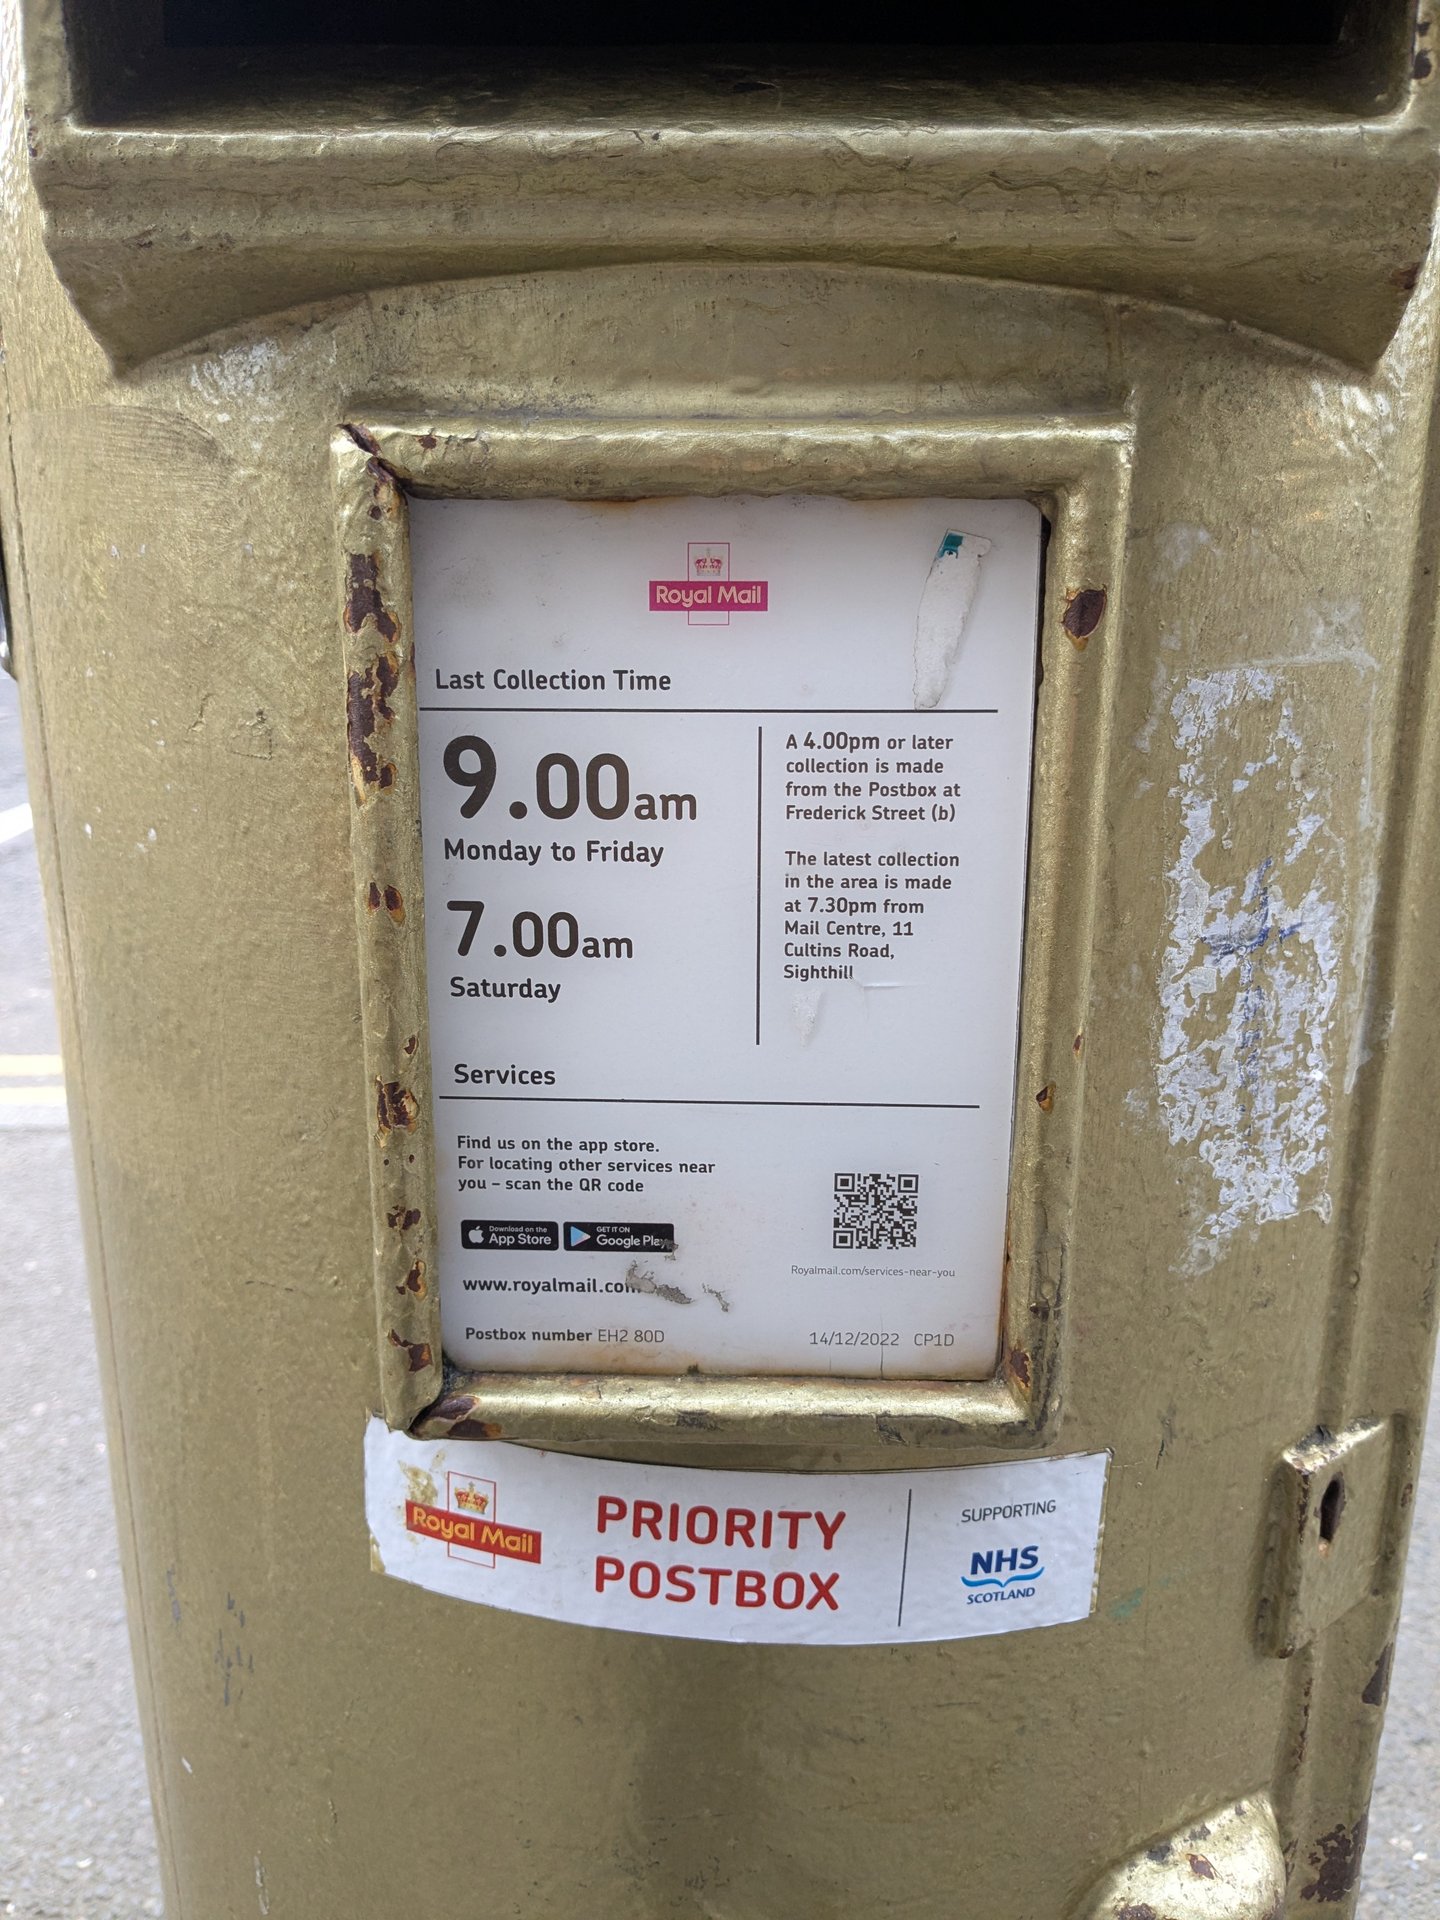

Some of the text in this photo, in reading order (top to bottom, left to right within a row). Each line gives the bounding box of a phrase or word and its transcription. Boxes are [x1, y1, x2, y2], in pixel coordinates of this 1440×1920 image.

[656, 586, 761, 607] Royal Mail
[436, 669, 671, 690] Last Collection Time
[786, 732, 953, 753] A 4.00pm or later
[787, 758, 943, 773] collection is made
[786, 781, 960, 797] from the Postbox at
[787, 804, 955, 822] Frederick Street (b)
[444, 838, 664, 867] Monday to Friday
[785, 851, 959, 866] The latest collection
[786, 874, 951, 889] in the area is made
[785, 897, 923, 916] at 7.30pm from
[785, 920, 913, 937] Mail Centre, 11
[785, 943, 894, 959] Cultins Road,
[784, 965, 853, 982] Sighthill
[450, 976, 560, 1003] Saturday
[454, 1064, 555, 1085] Services
[457, 1136, 659, 1154] Find us on the app store.
[458, 1156, 715, 1173] For locating other services near
[458, 1179, 486, 1191] you
[506, 1180, 540, 1190] scan
[547, 1178, 572, 1190] the
[580, 1178, 601, 1191] QR
[608, 1179, 643, 1192] code
[489, 1225, 522, 1233] Download
[535, 1225, 548, 1233] the
[489, 1233, 552, 1247] App Store
[596, 1234, 641, 1249] Google
[792, 1265, 955, 1278] Royalmail.com/services-near-you
[466, 1327, 526, 1340] Postbox
[532, 1329, 592, 1341] number
[599, 1329, 628, 1344] EH2
[810, 1332, 954, 1346] 14/12/2022 CP1D
[961, 1500, 1056, 1523] SUPPORTING
[413, 1506, 534, 1554] Royal Mail
[598, 1496, 846, 1550] PRIORITY
[970, 1545, 1039, 1574] NHS
[596, 1556, 839, 1610] POSTBOX
[967, 1588, 1035, 1604] SCOTLAND
